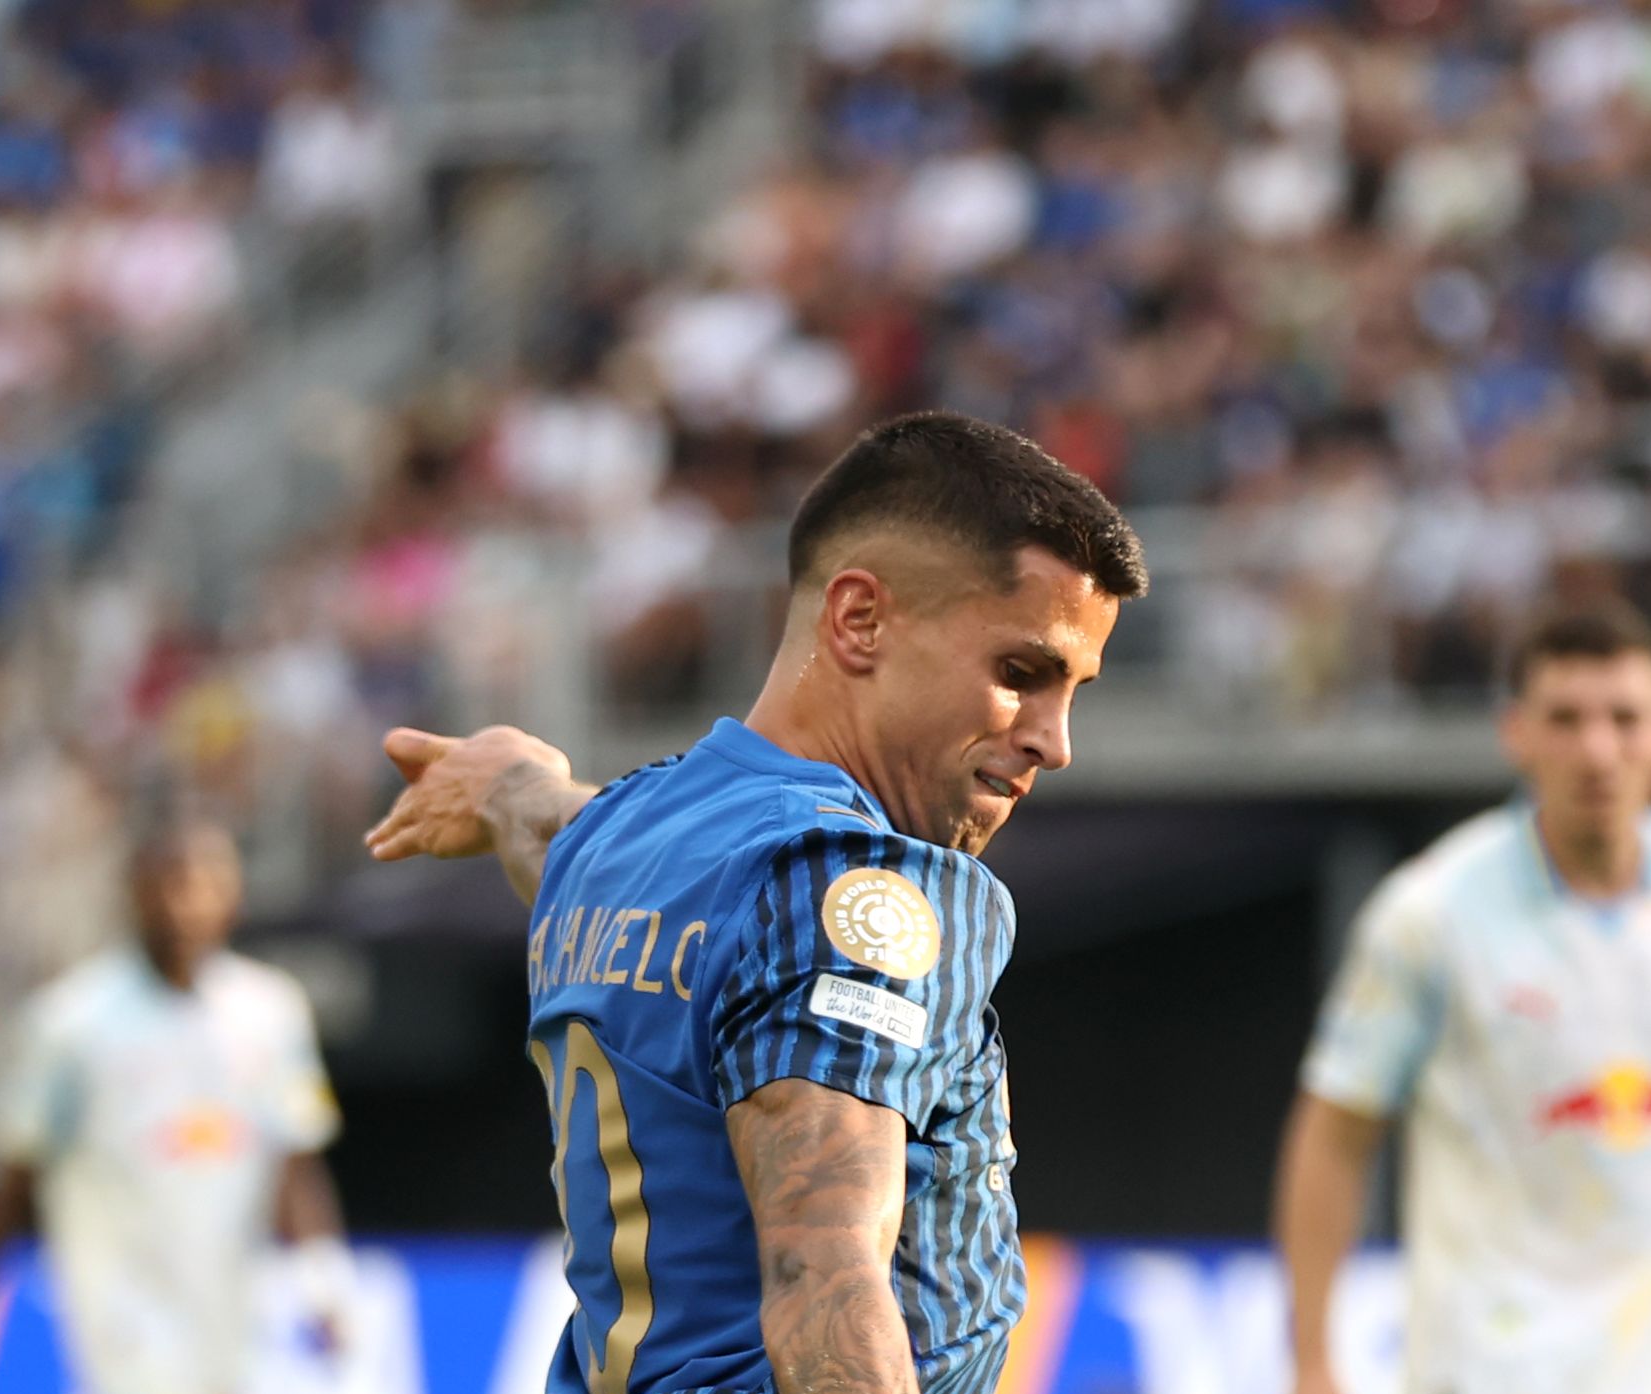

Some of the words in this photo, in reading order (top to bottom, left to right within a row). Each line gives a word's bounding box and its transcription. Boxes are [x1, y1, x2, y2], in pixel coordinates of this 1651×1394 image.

[838, 880, 888, 906] WORLD
[835, 909, 858, 945] CLUB
[826, 996, 847, 1012] the
[849, 1002, 884, 1024] World
